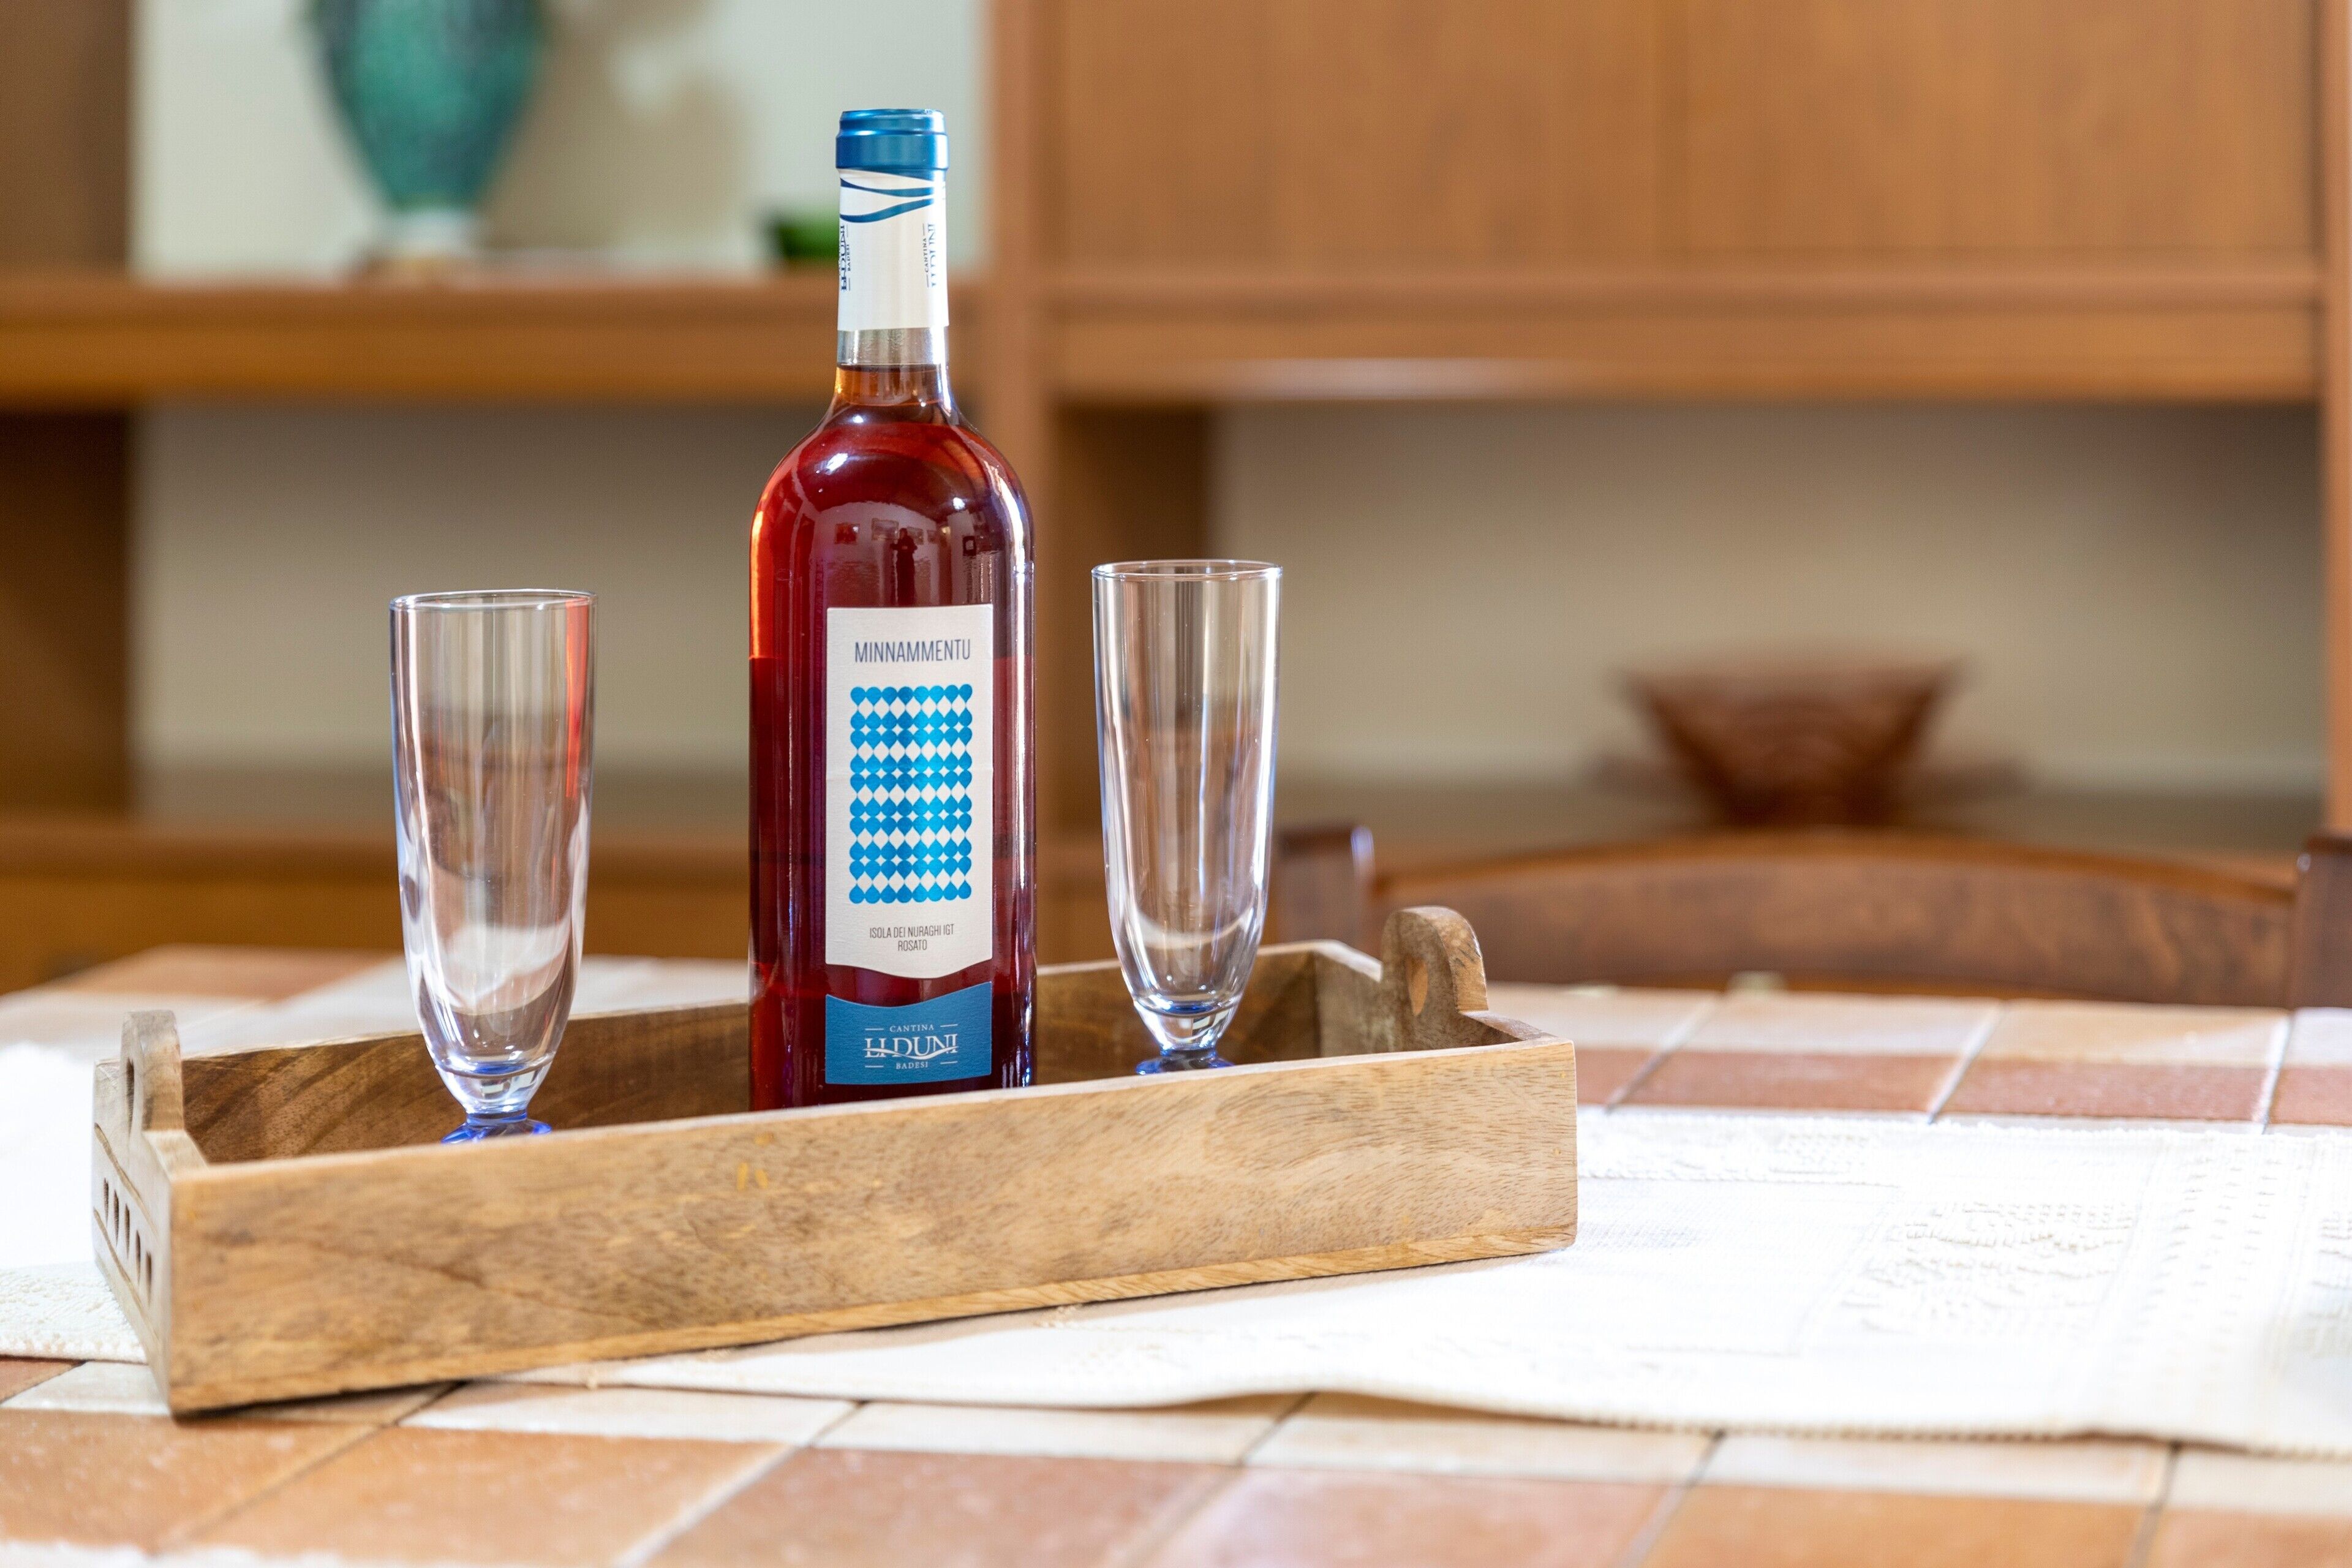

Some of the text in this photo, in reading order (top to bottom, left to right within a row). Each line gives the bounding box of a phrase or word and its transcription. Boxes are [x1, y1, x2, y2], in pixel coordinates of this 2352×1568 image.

[854, 639, 971, 663] MINNAMMENTU
[869, 923, 954, 939] ISOLA DEI NURAGHI IGT
[897, 939, 927, 952] ROSATO
[889, 1023, 935, 1033] CANTINA
[892, 1033, 958, 1059] DUNI
[895, 1061, 929, 1070] BADESI
